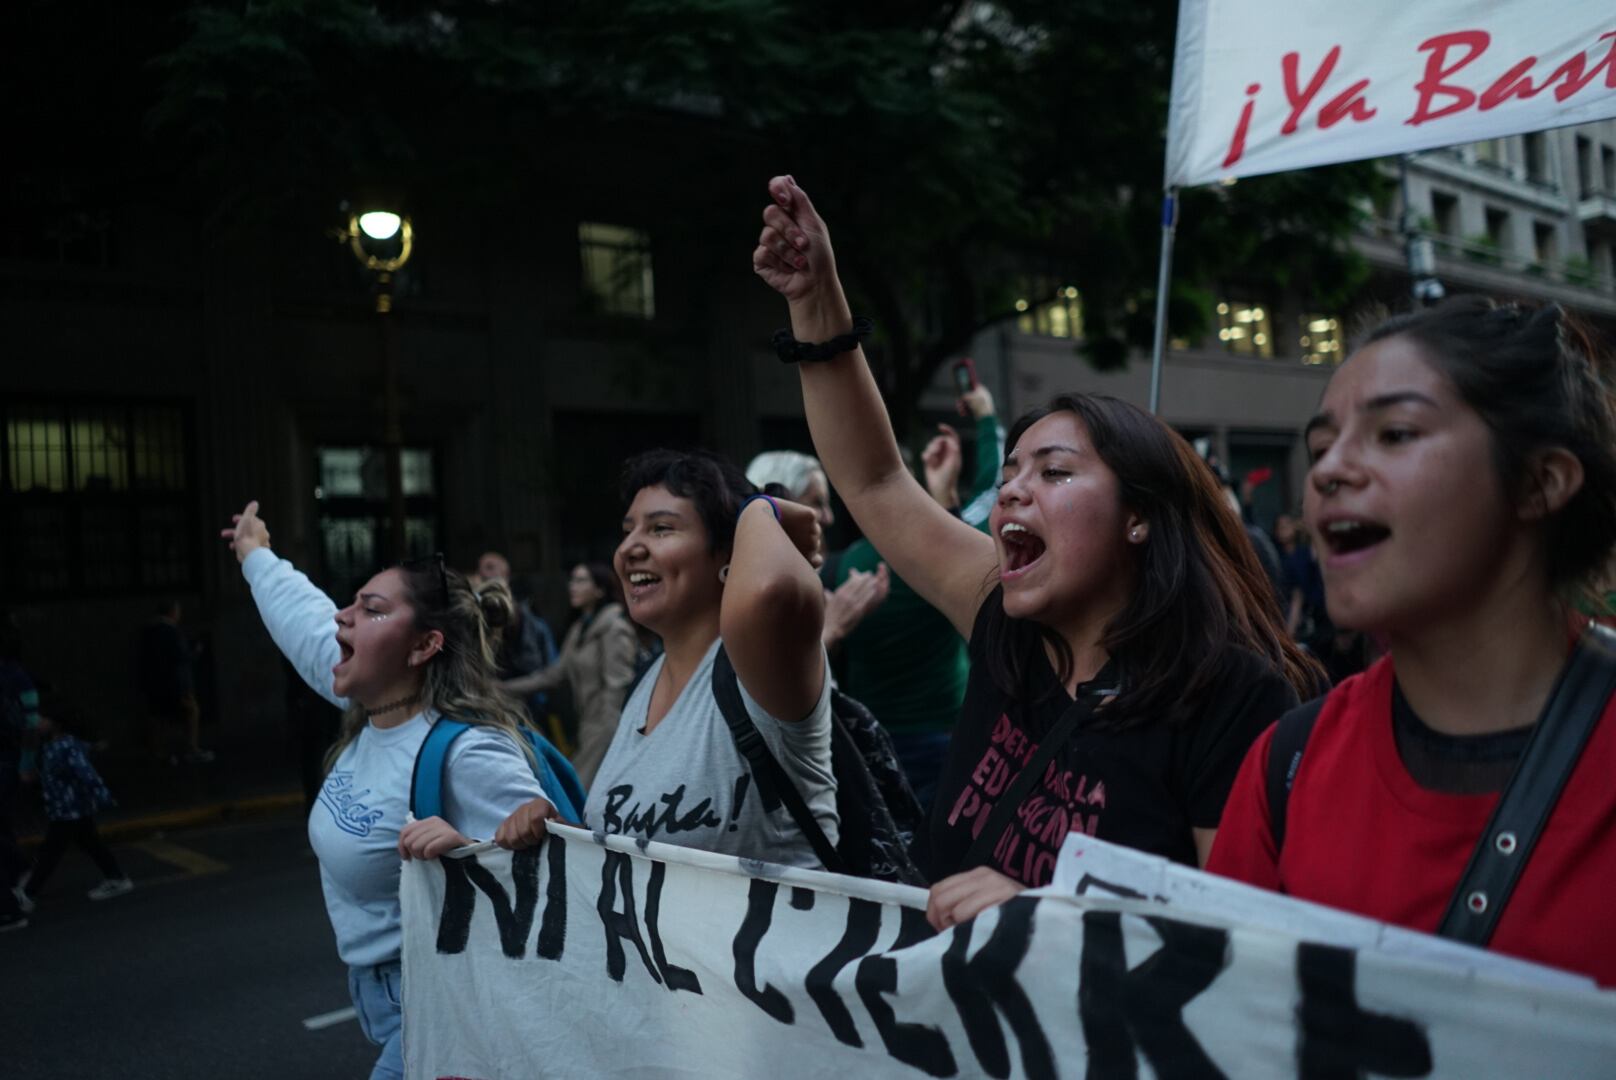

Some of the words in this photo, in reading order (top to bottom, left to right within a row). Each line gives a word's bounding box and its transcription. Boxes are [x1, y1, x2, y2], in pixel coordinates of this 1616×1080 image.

[1222, 45, 1377, 168] ¡Ya
[603, 773, 750, 839] Basta!
[437, 833, 567, 960] NI
[597, 848, 703, 994] AL
